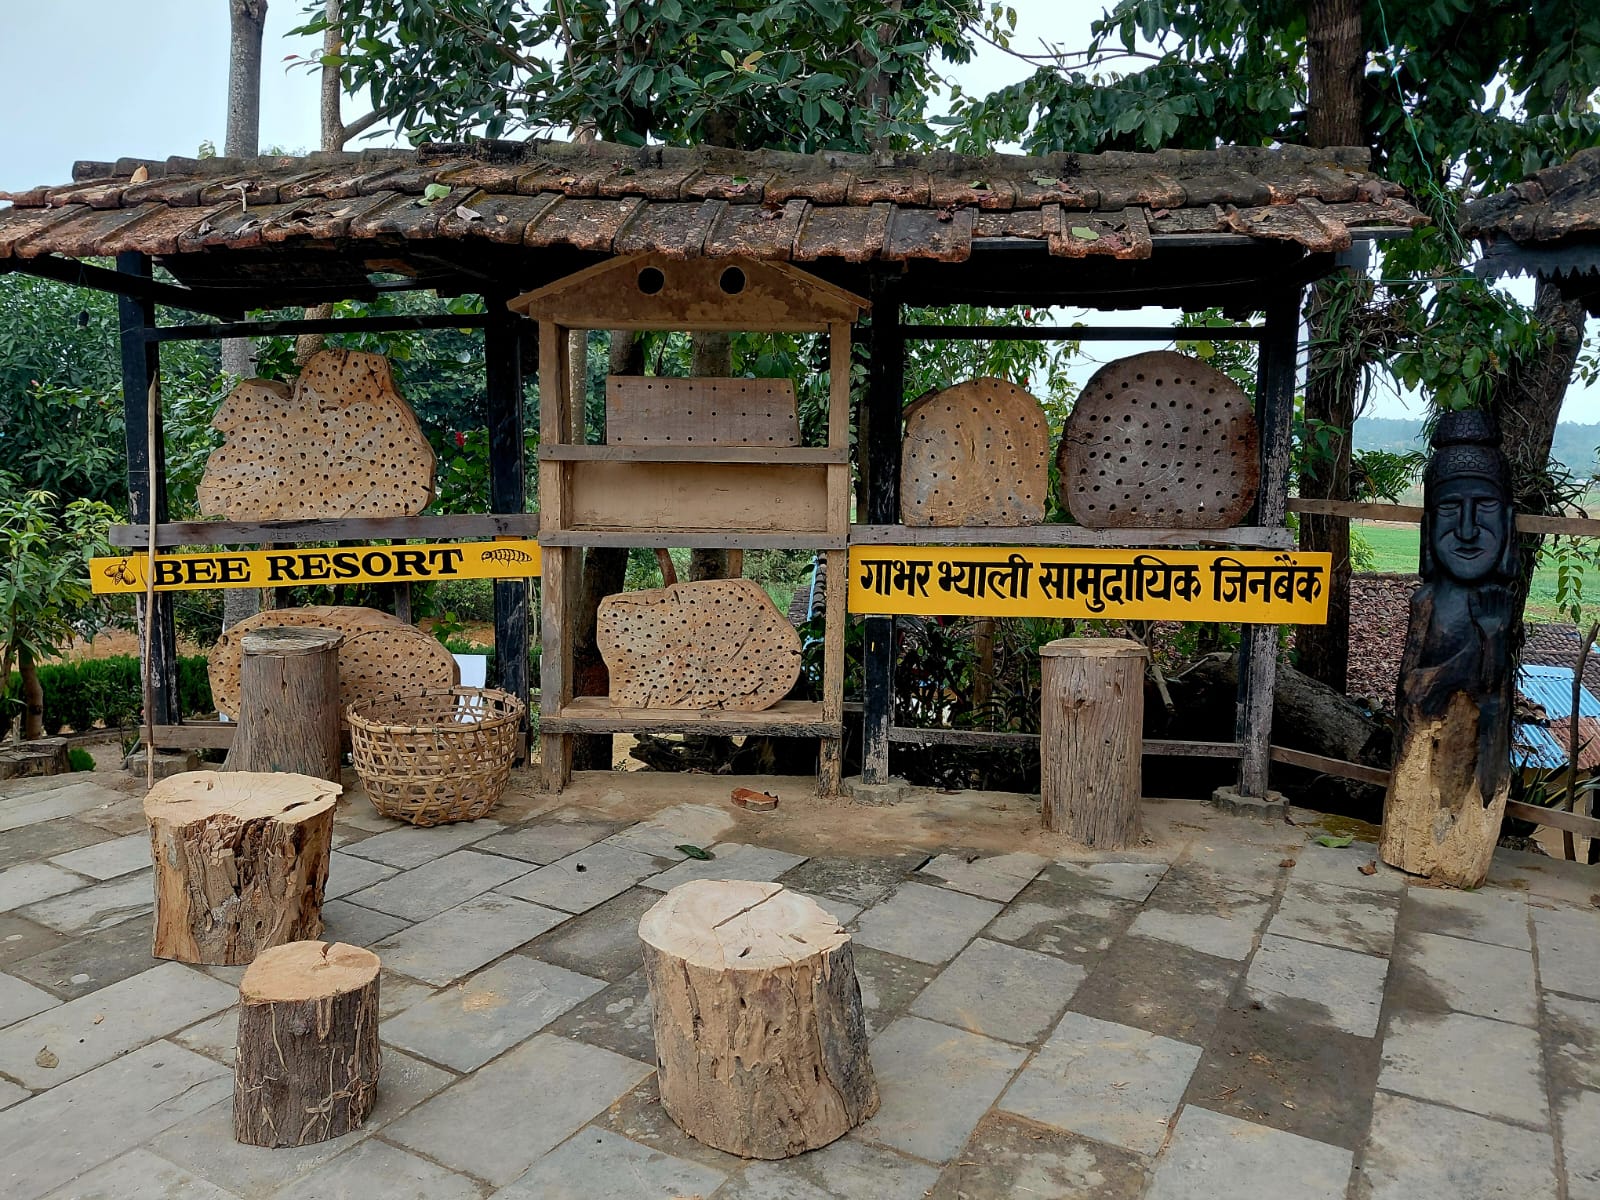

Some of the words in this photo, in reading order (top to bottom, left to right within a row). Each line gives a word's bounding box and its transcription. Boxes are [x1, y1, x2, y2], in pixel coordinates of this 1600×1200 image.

[153, 557, 251, 586] BEE
[266, 549, 464, 581] RESORT
[860, 559, 933, 597] गाभर
[937, 553, 1034, 599] भ्याली
[1038, 554, 1202, 613] सामुदायिक
[1209, 554, 1324, 604] जिनबैंक
